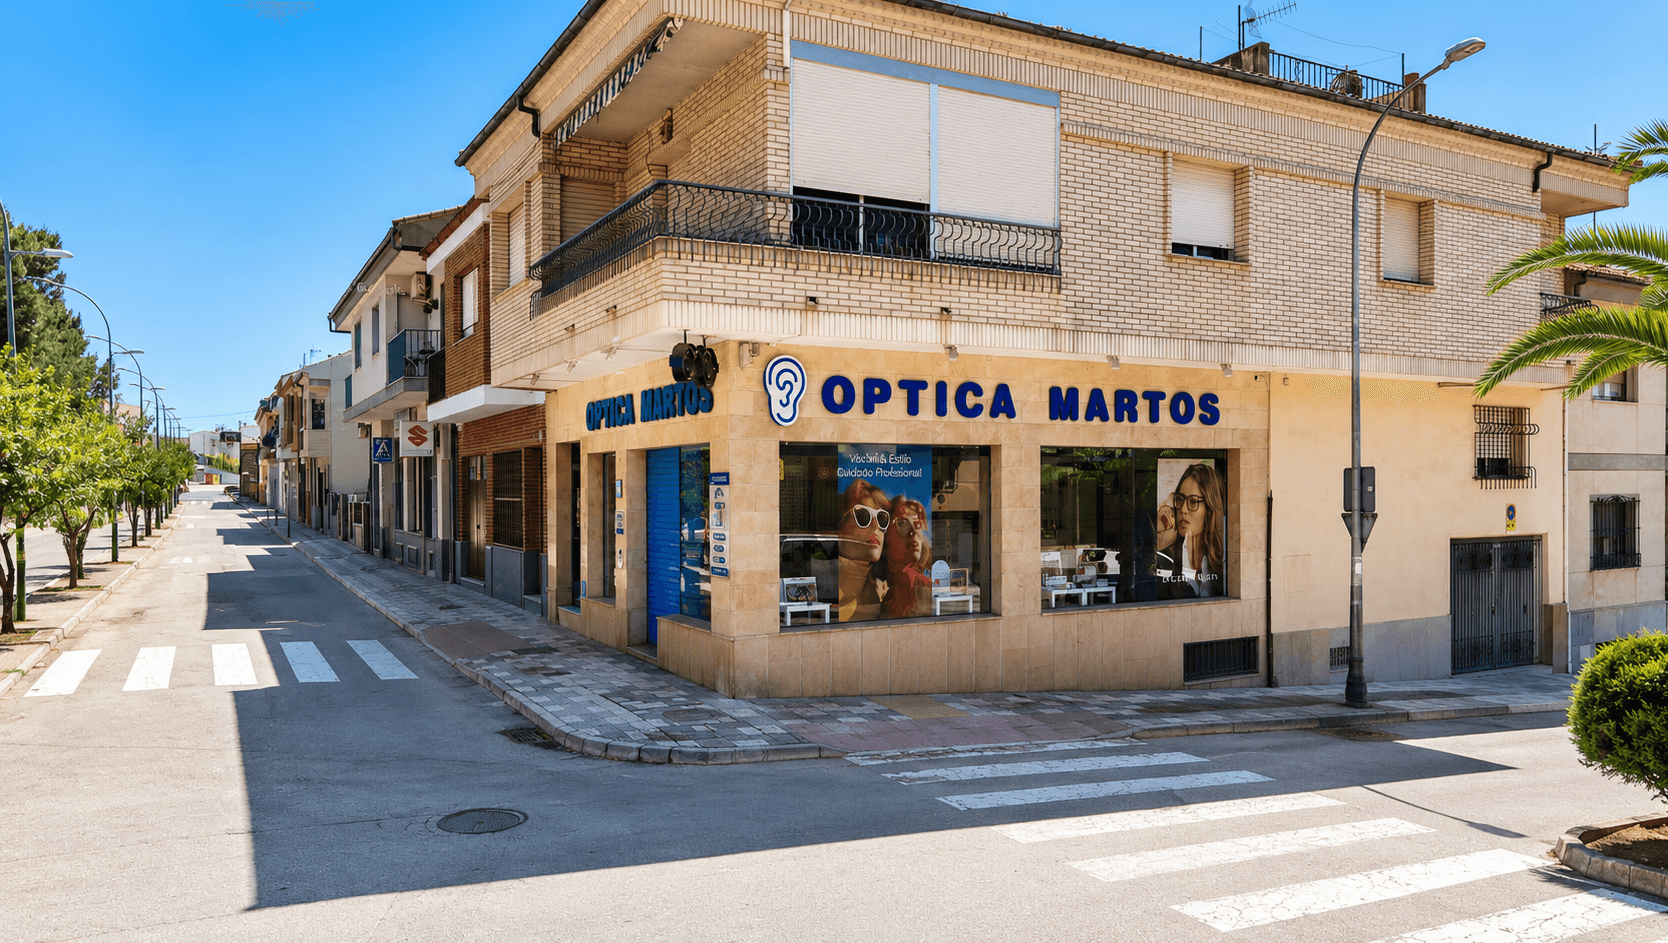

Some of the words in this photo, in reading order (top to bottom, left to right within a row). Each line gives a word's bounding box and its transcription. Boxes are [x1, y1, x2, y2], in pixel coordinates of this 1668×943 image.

[586, 393, 636, 431] OPTICA
[821, 375, 1017, 419] OPTICA
[1049, 386, 1220, 426] MARTOS
